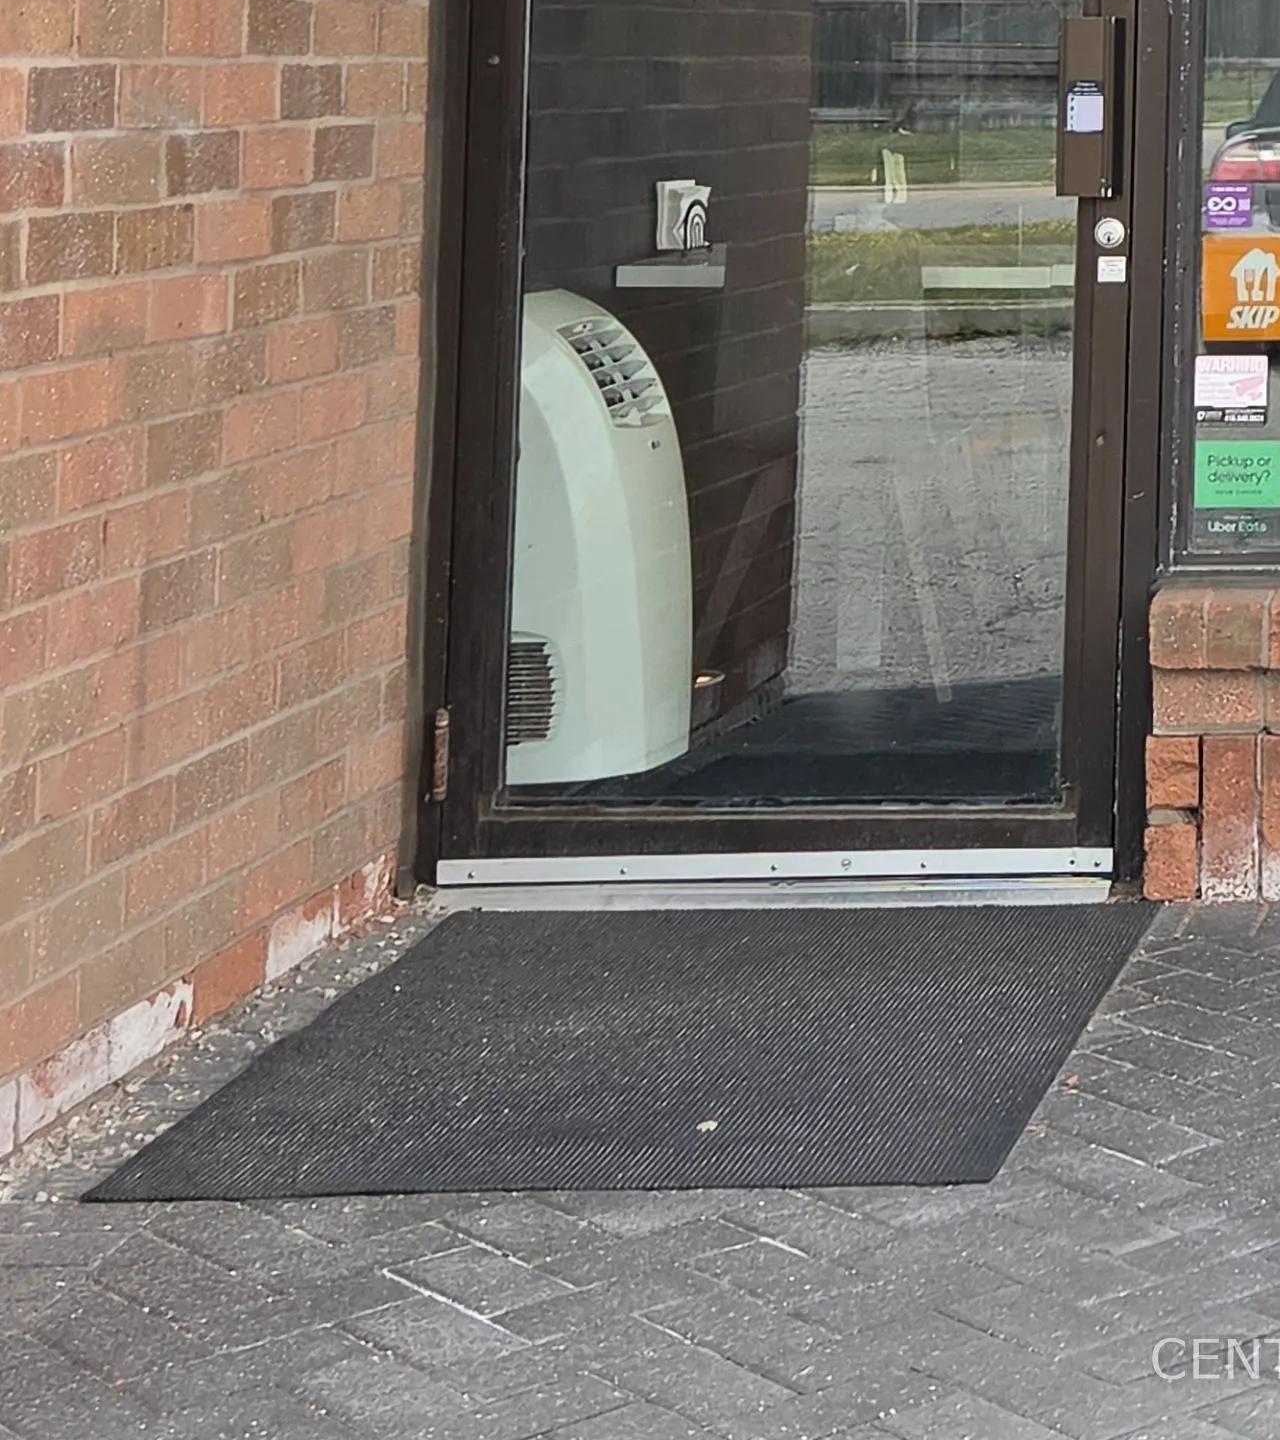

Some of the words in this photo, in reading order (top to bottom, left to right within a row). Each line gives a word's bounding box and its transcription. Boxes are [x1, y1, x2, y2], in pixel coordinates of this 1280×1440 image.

[1226, 305, 1280, 329] SKIP
[1207, 454, 1255, 469] Pickup
[1256, 456, 1272, 467] or
[1207, 469, 1272, 486] delivery?
[1207, 520, 1237, 533] Uber
